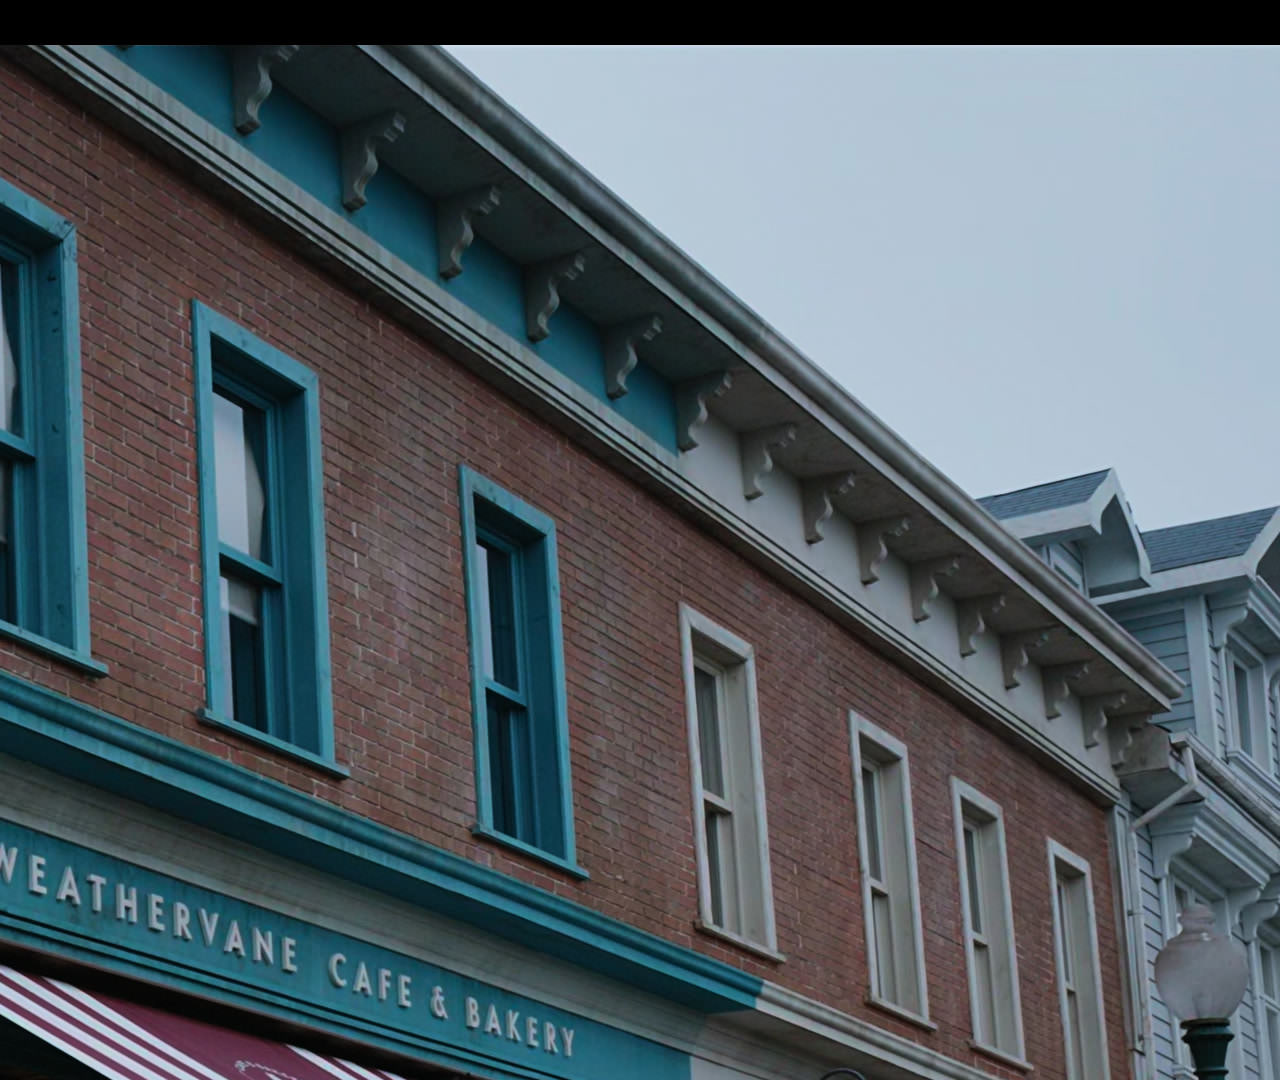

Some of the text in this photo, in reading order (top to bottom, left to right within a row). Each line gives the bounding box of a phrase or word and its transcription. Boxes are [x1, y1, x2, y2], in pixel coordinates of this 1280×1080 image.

[328, 953, 412, 1008] CAFE
[430, 985, 448, 1020] &
[465, 997, 575, 1057] BAKERY
